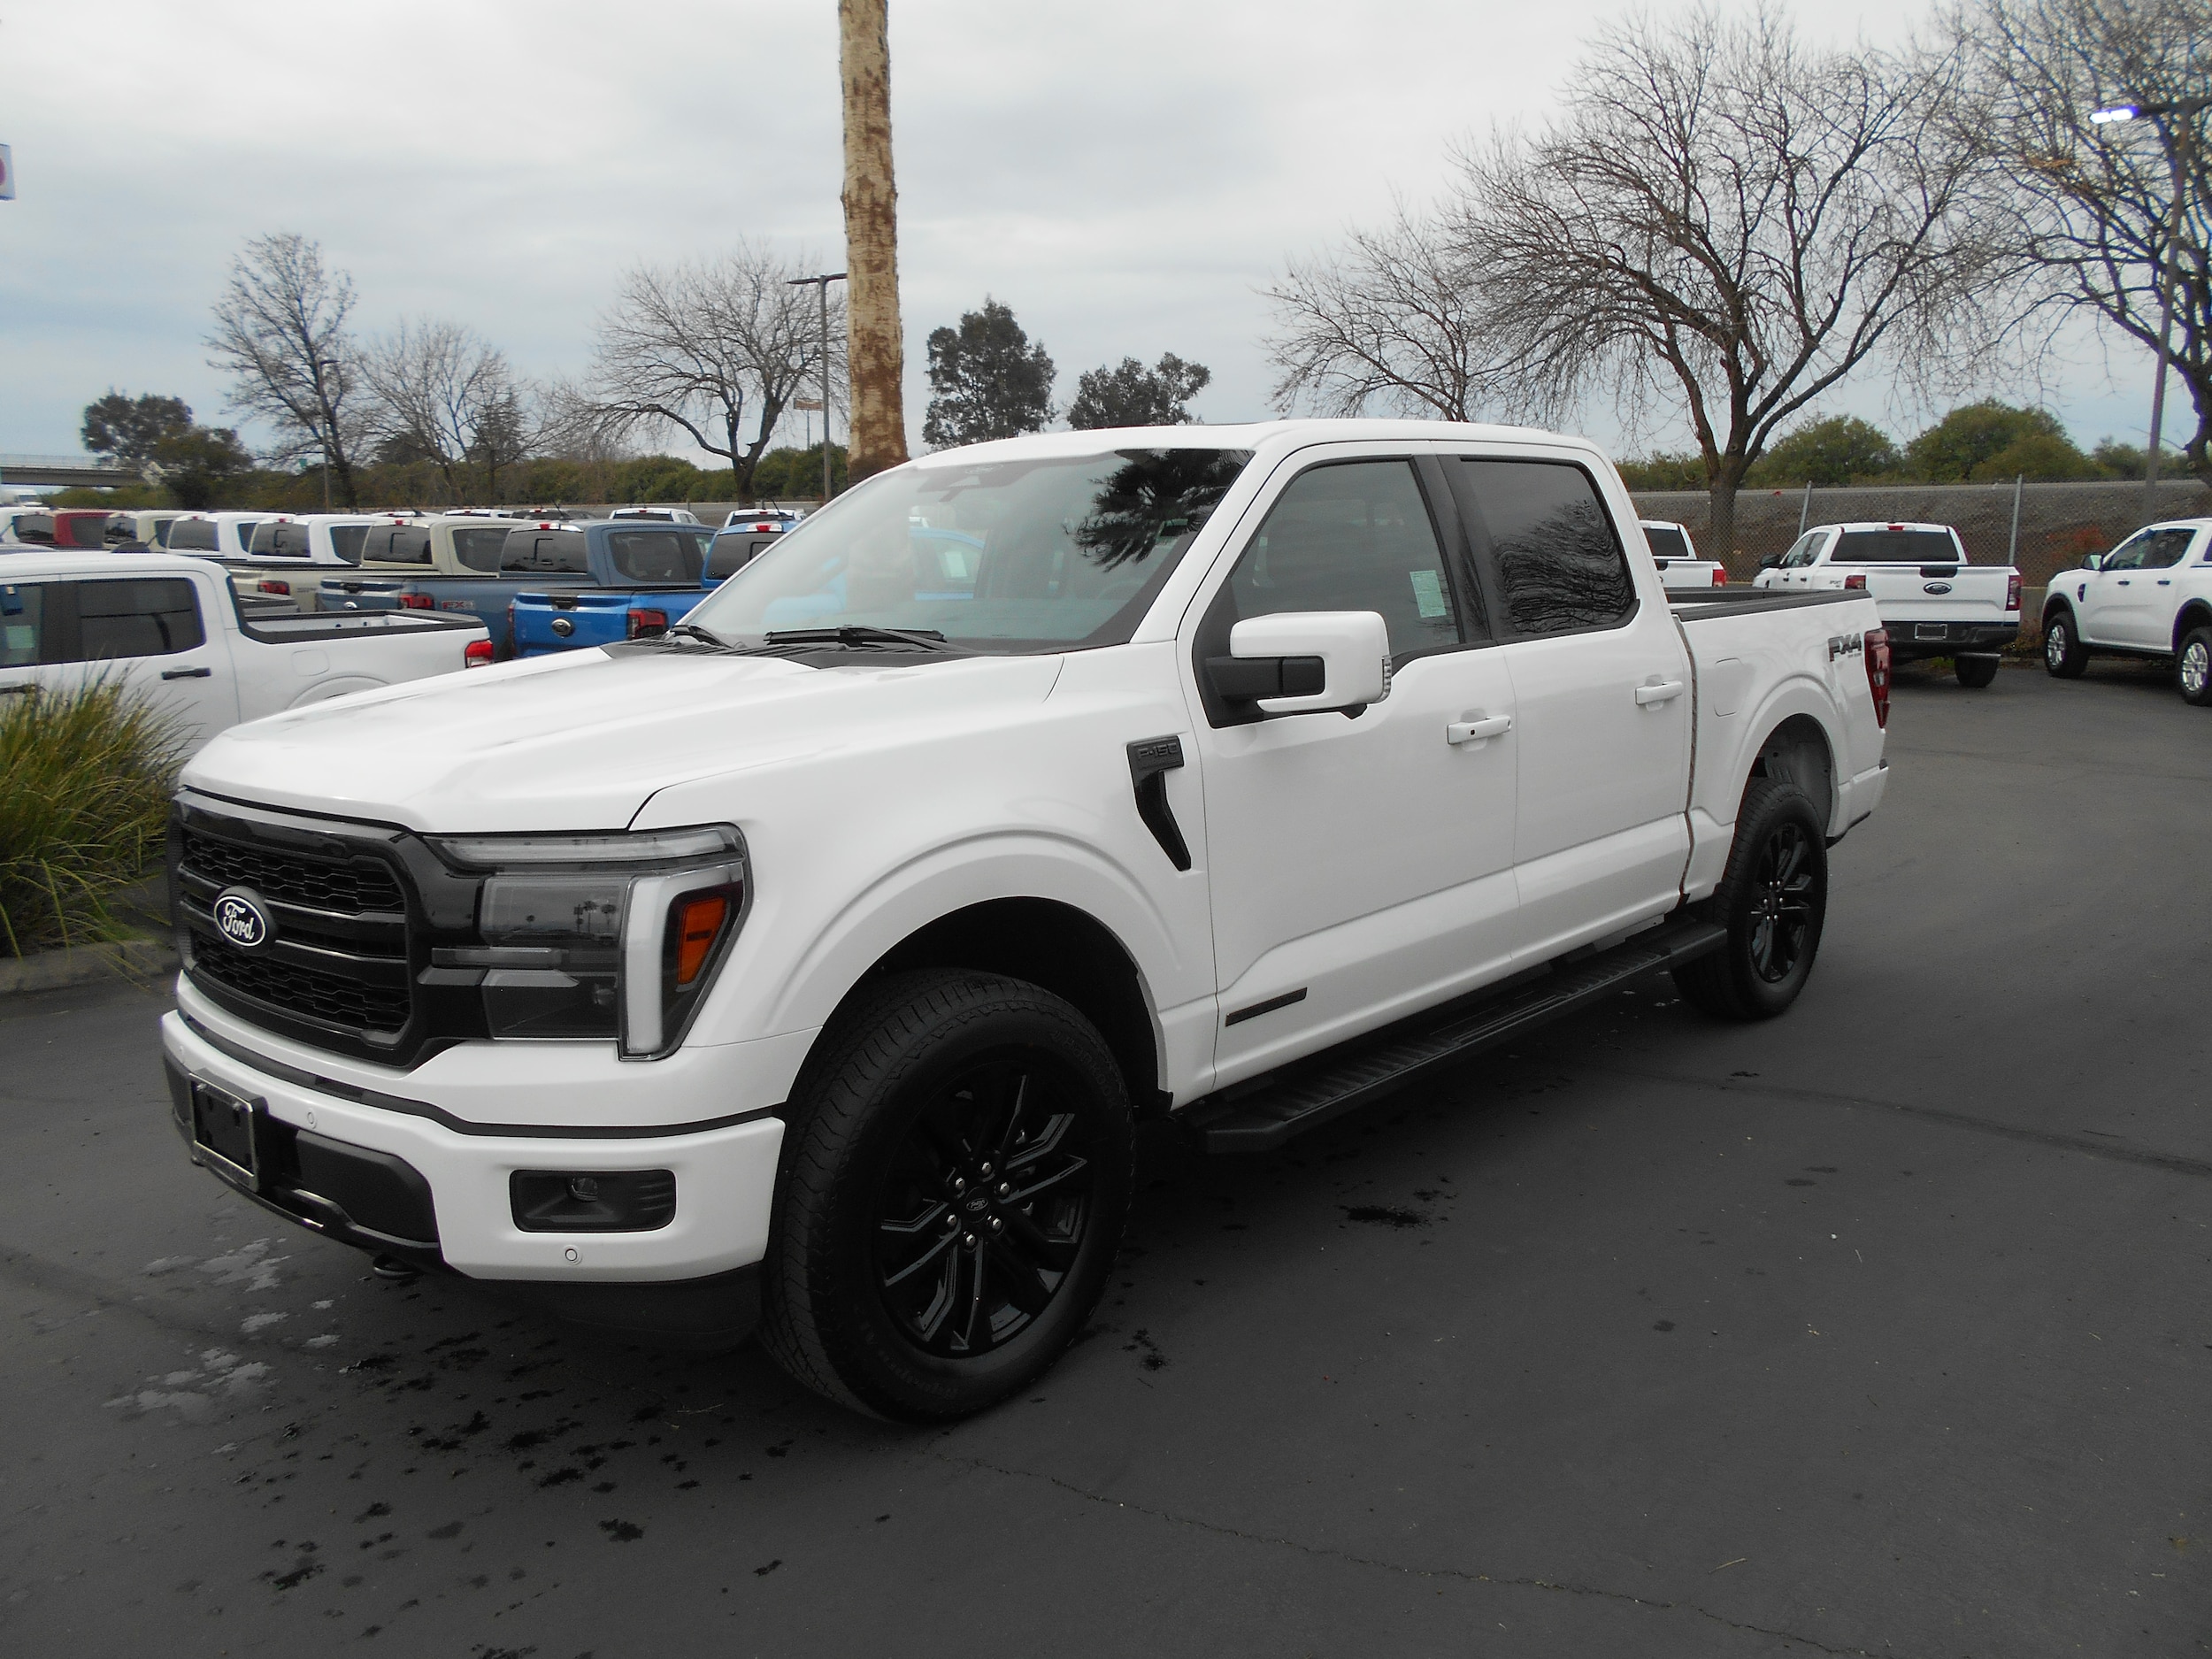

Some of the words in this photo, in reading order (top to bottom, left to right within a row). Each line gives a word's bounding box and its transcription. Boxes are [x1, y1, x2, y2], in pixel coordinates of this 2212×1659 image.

[1828, 633, 1862, 662] FX4
[1138, 742, 1178, 759] F-150
[222, 901, 256, 941] Ford
